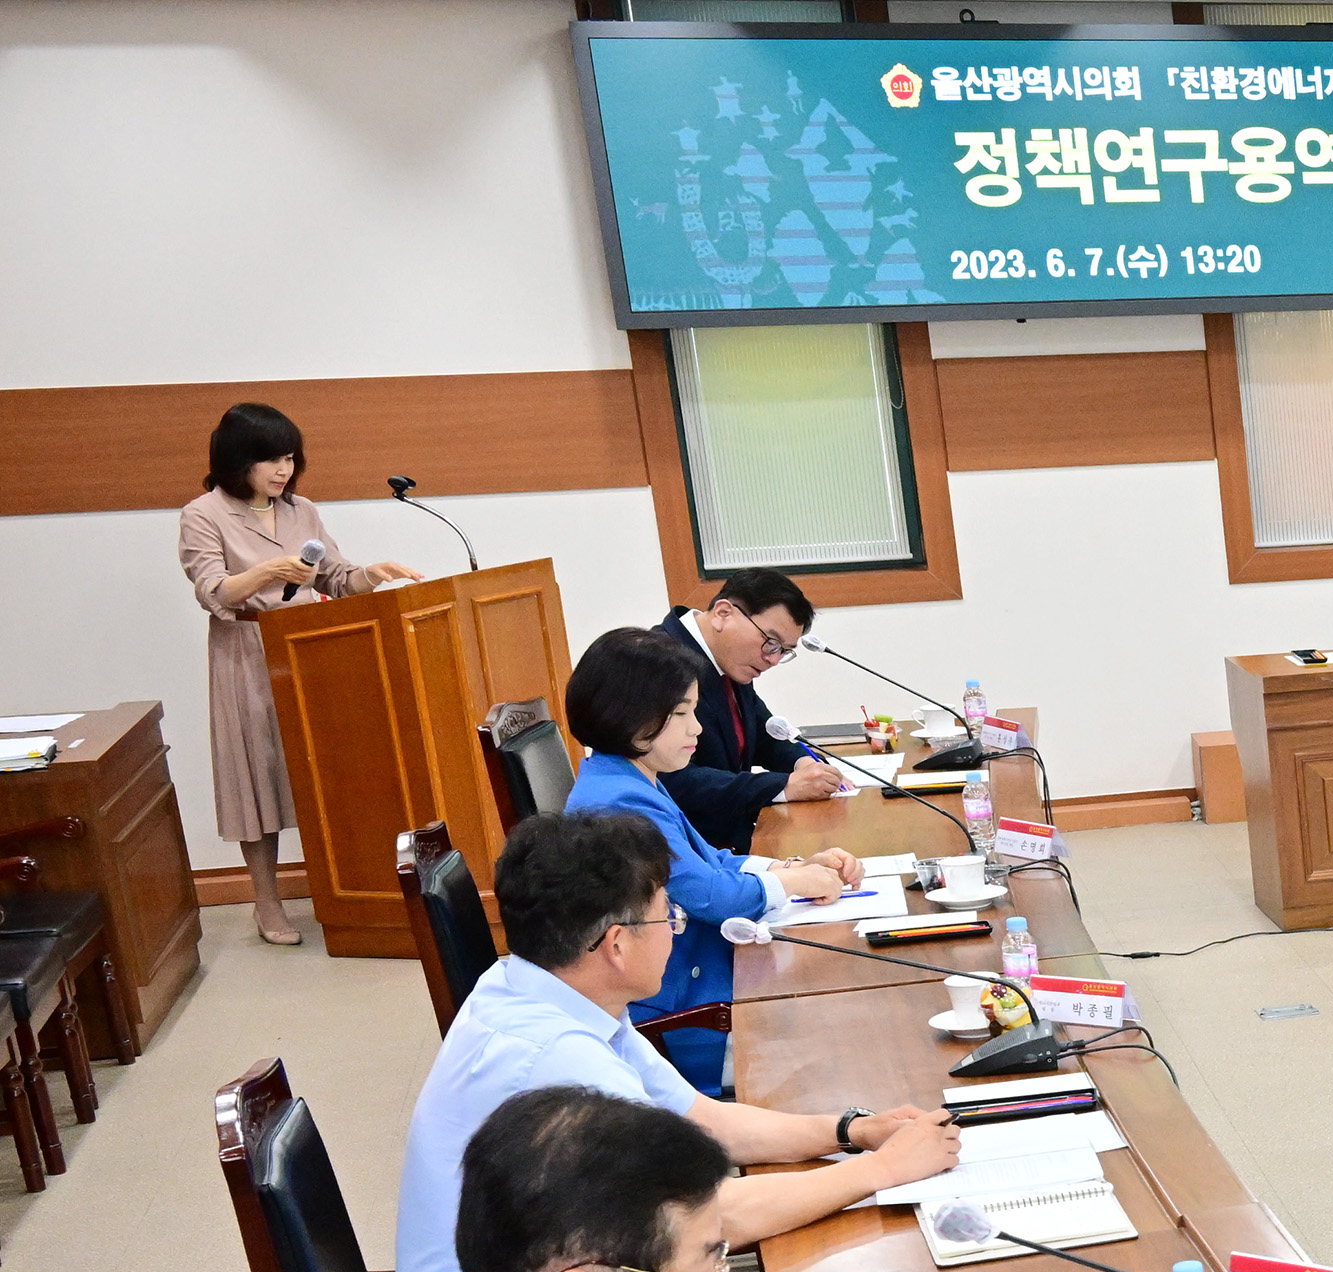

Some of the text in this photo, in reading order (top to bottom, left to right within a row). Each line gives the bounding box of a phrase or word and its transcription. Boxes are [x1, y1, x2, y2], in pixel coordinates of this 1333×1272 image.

[893, 81, 912, 92] 의회
[931, 66, 1141, 101] 울산광역시의회
[951, 244, 1261, 279] 2023. 6. 7.(수) 13:20
[1072, 1002, 1112, 1019] 박종필
